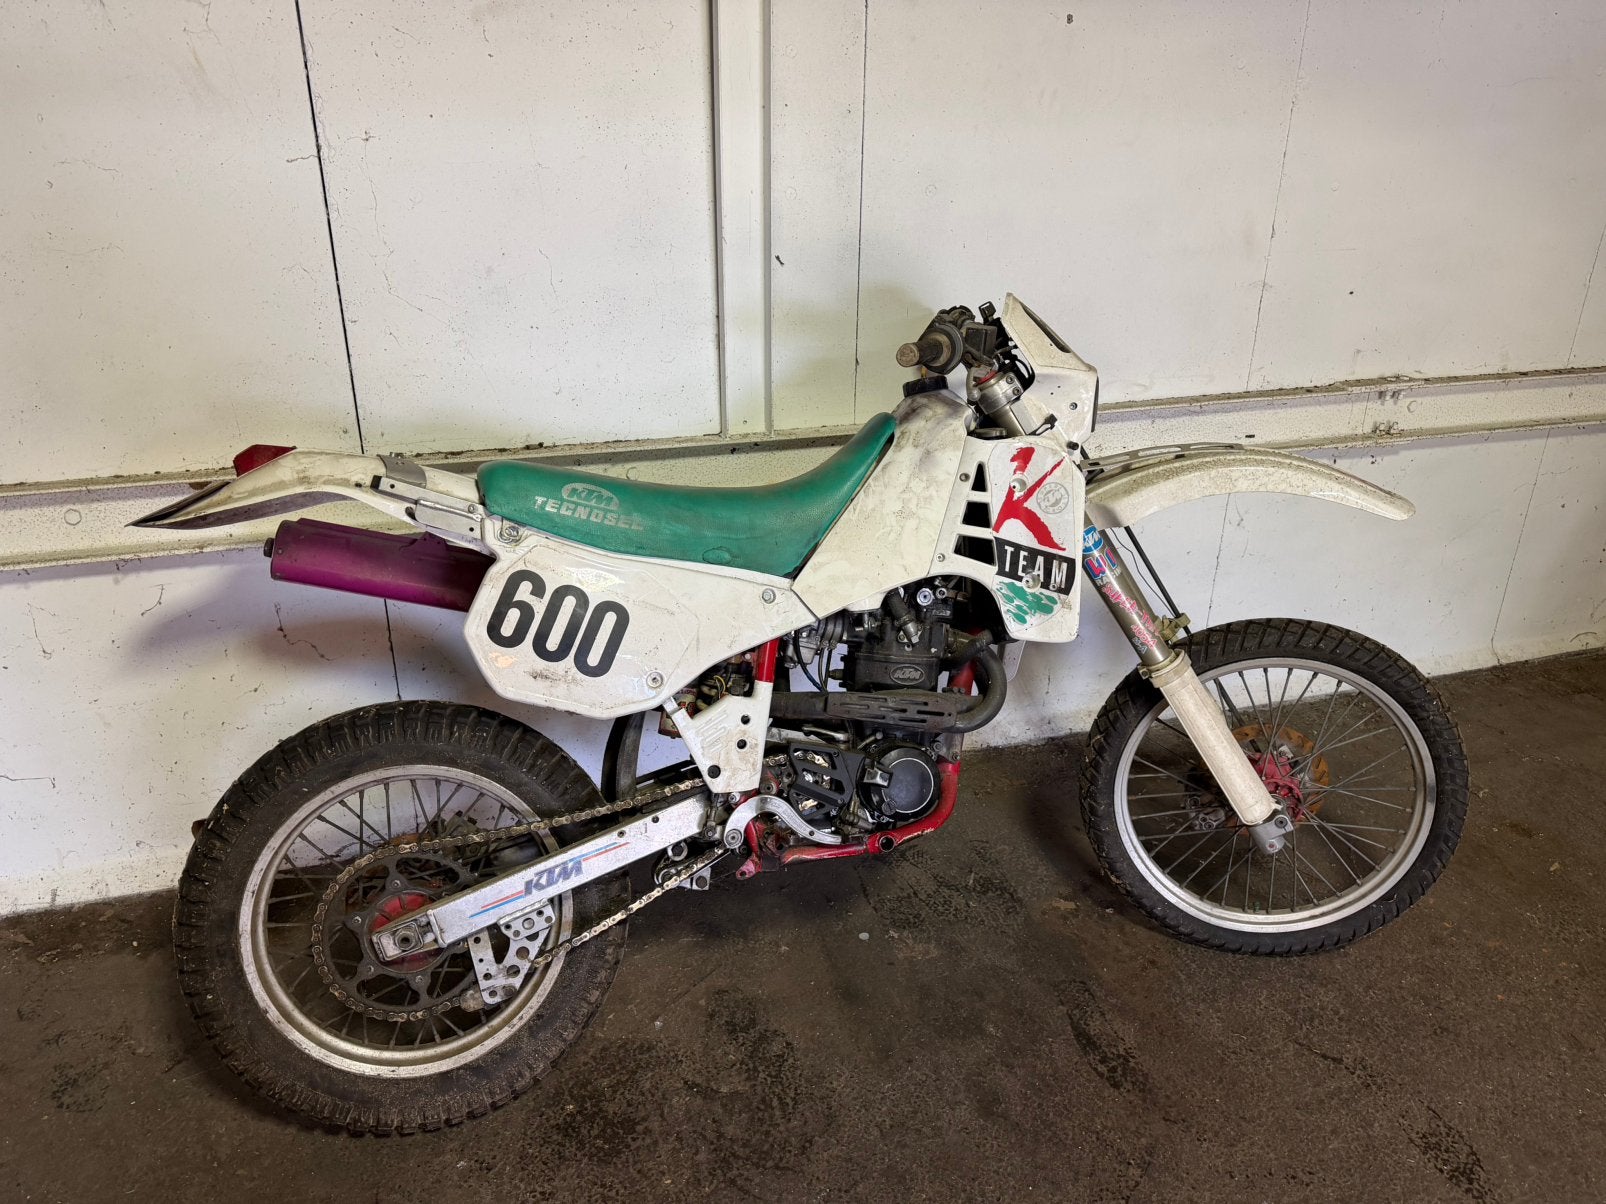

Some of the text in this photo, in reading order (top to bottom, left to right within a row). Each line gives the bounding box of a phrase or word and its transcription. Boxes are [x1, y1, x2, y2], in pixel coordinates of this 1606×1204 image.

[567, 486, 615, 508] KTM
[1004, 545, 1068, 589] TEAM
[486, 569, 630, 678] 600
[893, 668, 921, 679] KTM
[524, 859, 583, 896] KTM
